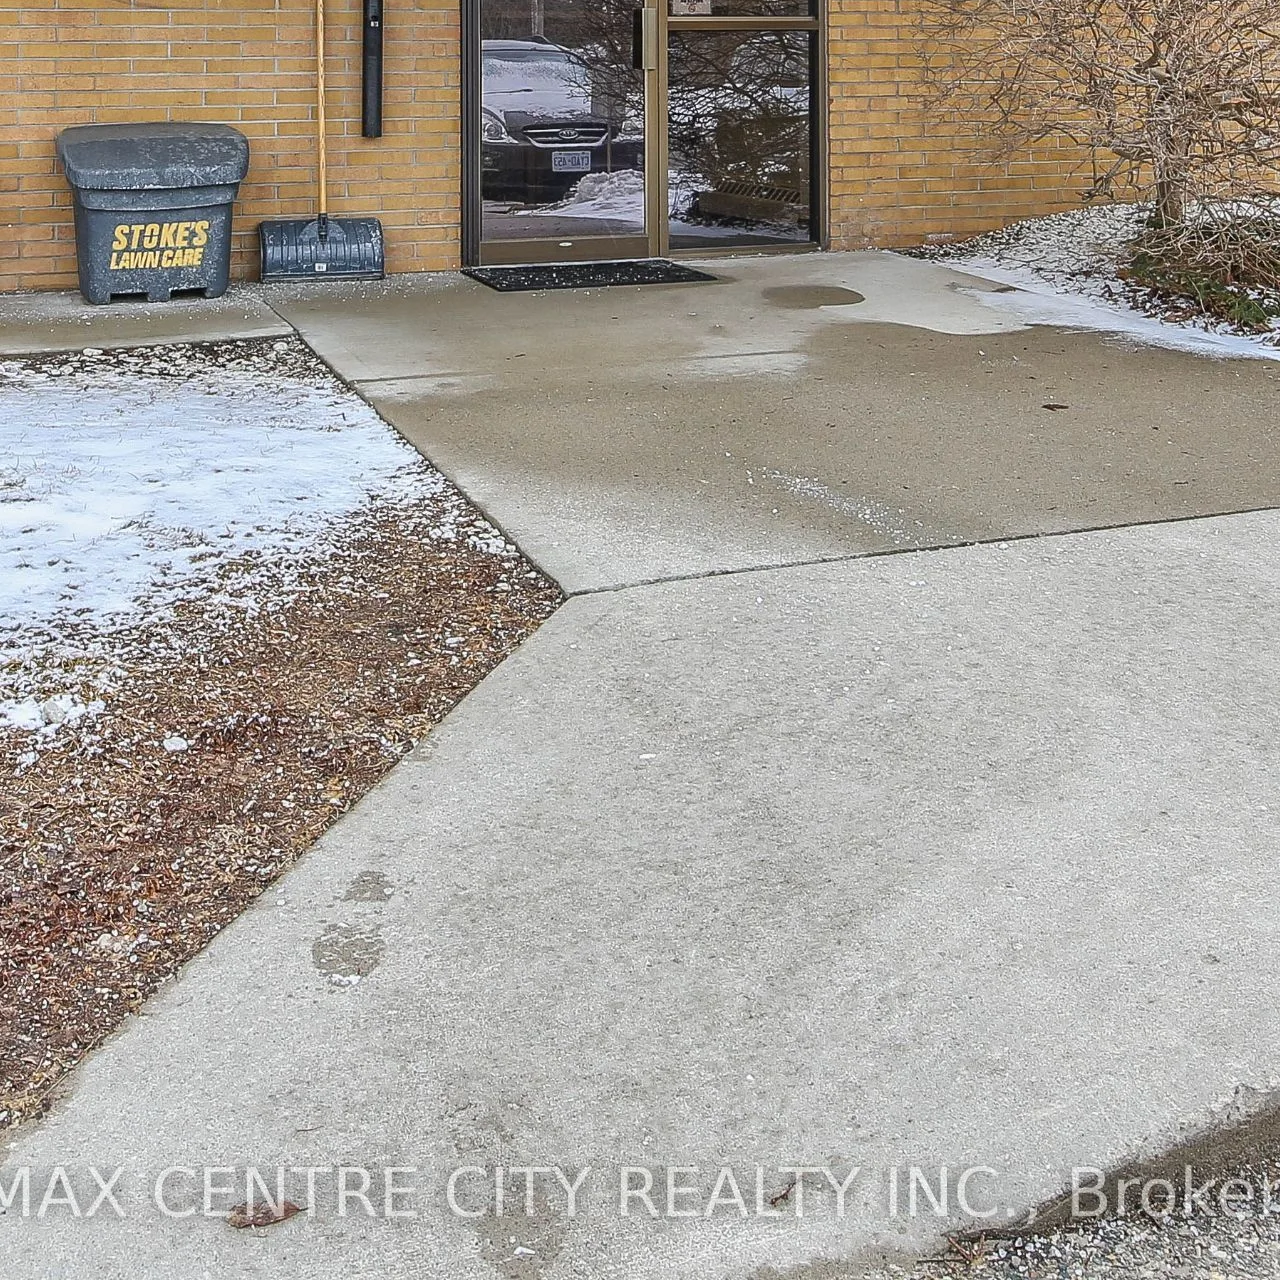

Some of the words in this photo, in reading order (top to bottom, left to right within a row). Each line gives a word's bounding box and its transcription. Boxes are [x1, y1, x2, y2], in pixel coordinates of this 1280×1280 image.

[112, 220, 209, 250] STOKE'S
[110, 251, 160, 270] LAWN
[161, 248, 204, 268] CARE
